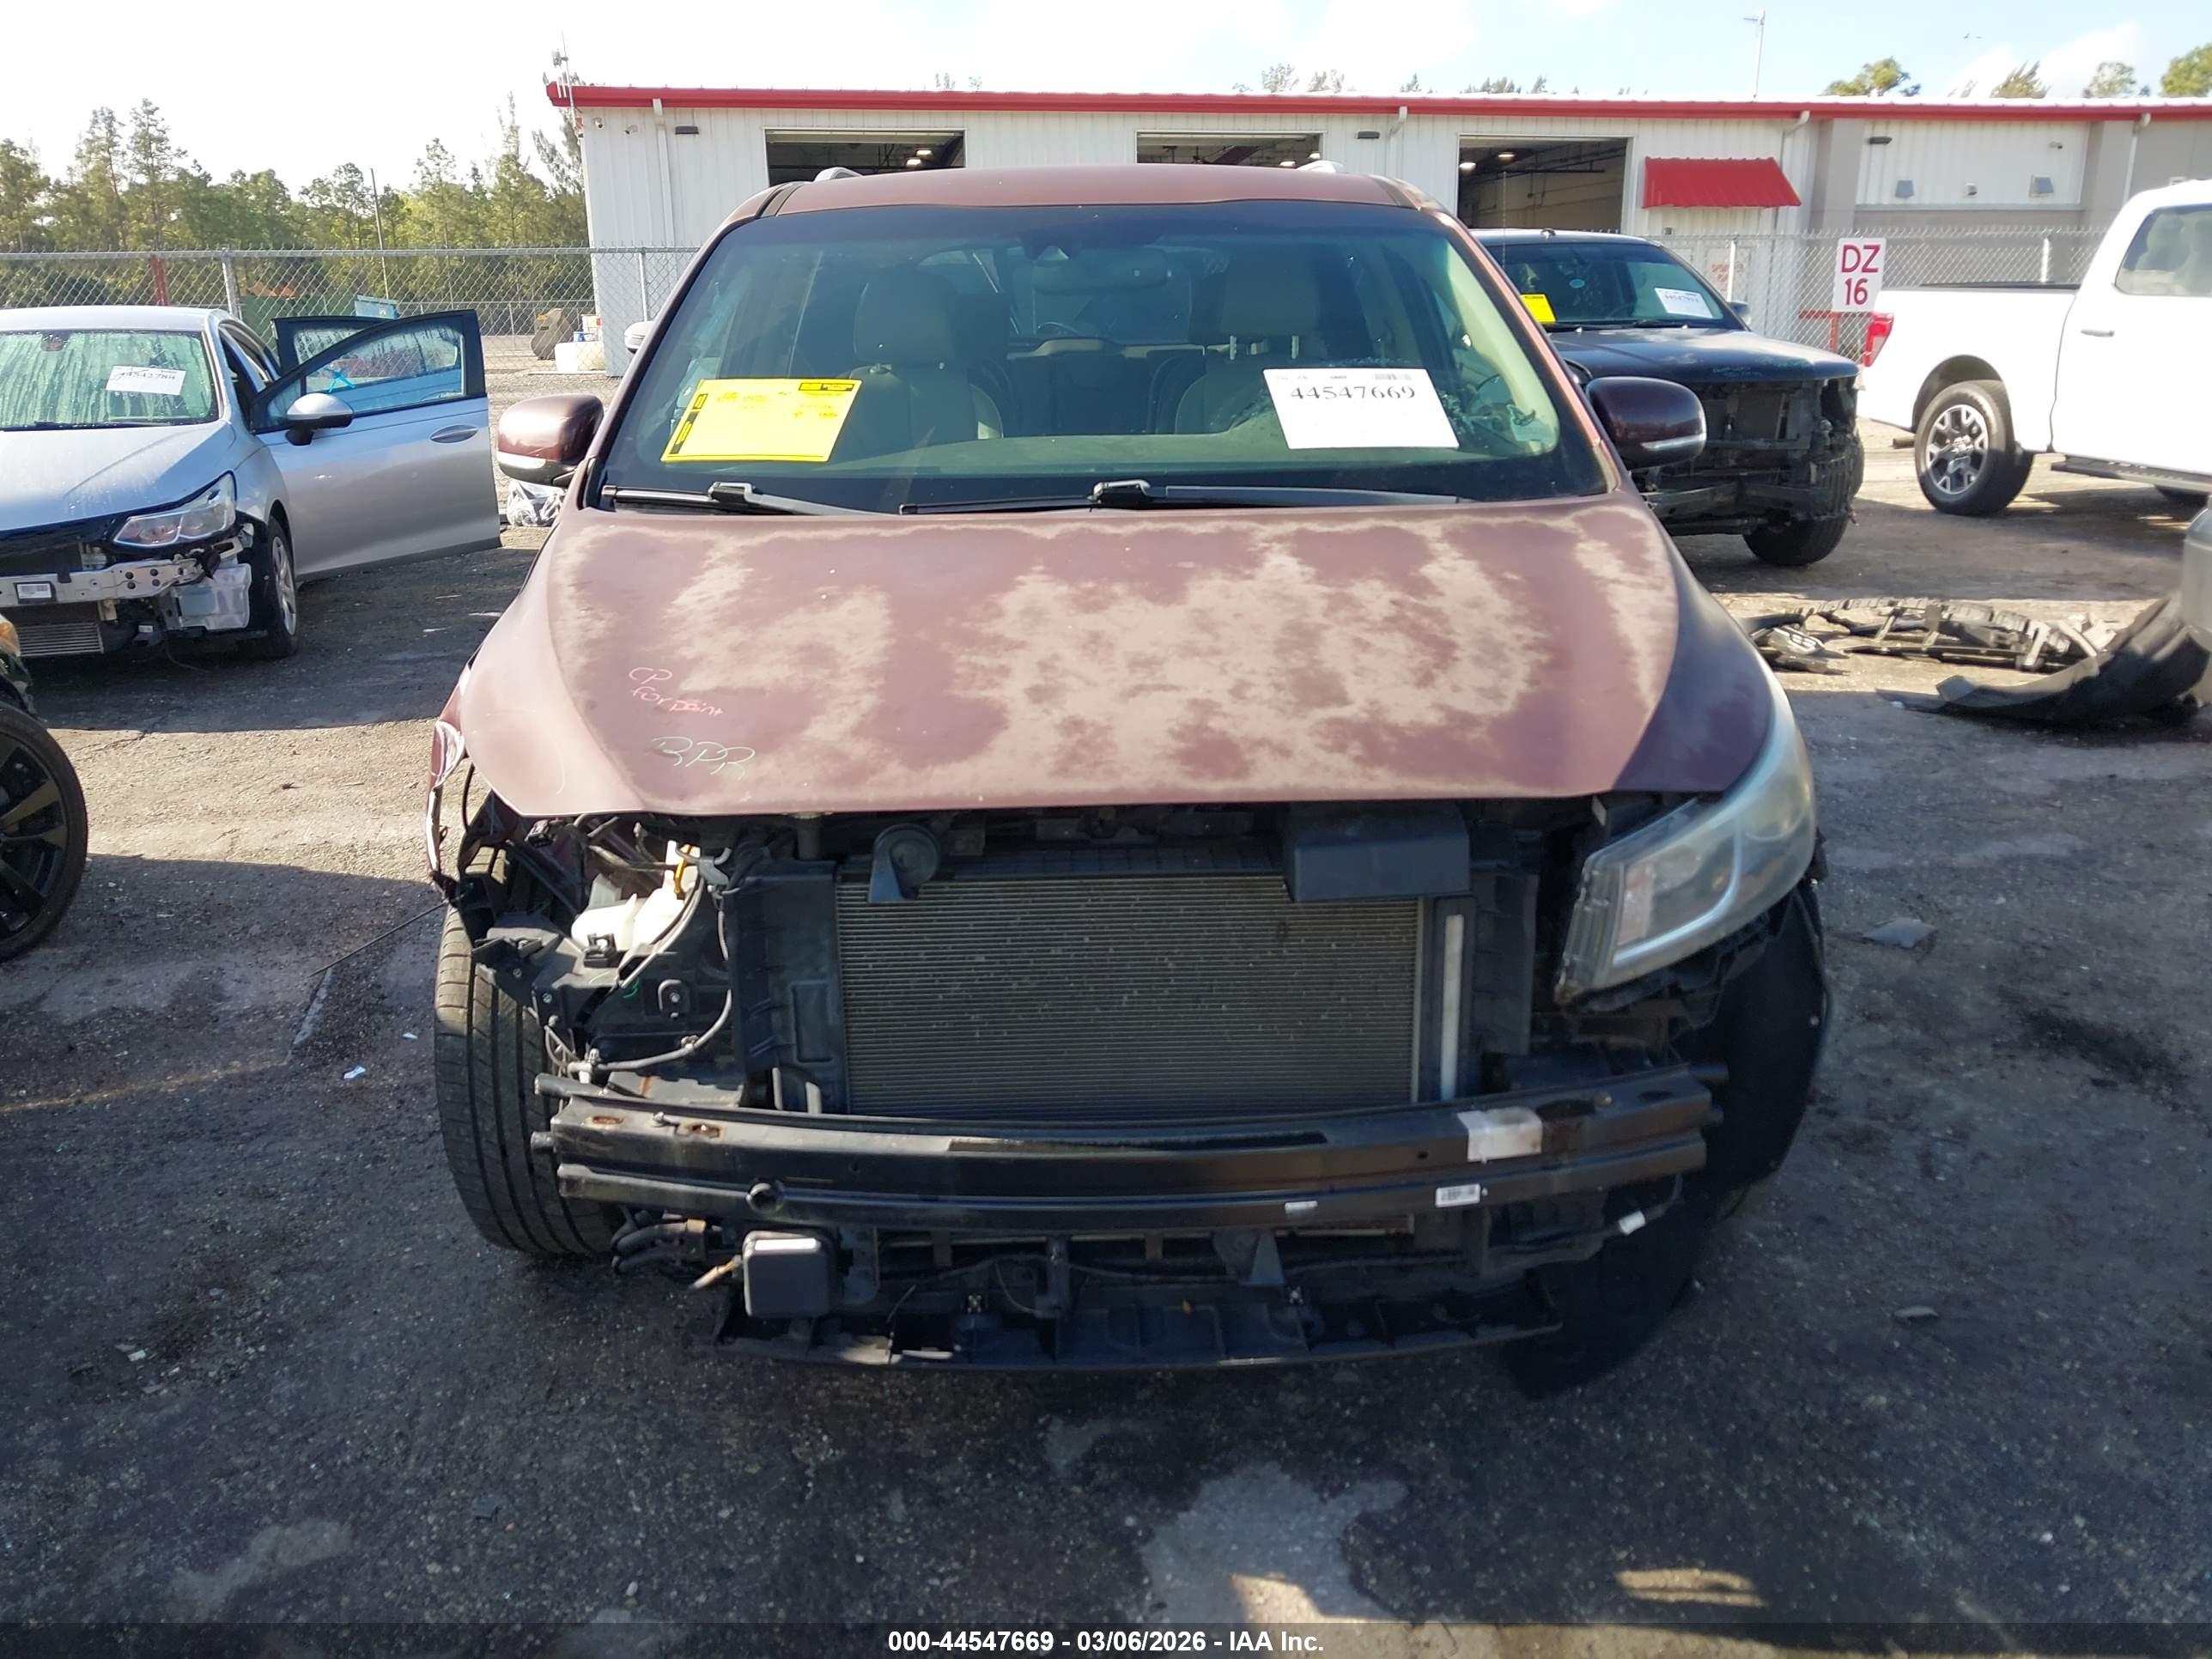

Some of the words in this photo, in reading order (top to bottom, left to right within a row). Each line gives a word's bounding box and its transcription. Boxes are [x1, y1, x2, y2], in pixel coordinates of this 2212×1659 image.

[1841, 244, 1881, 273] DZ
[1844, 277, 1869, 306] 16
[1291, 386, 1416, 399] 44547669
